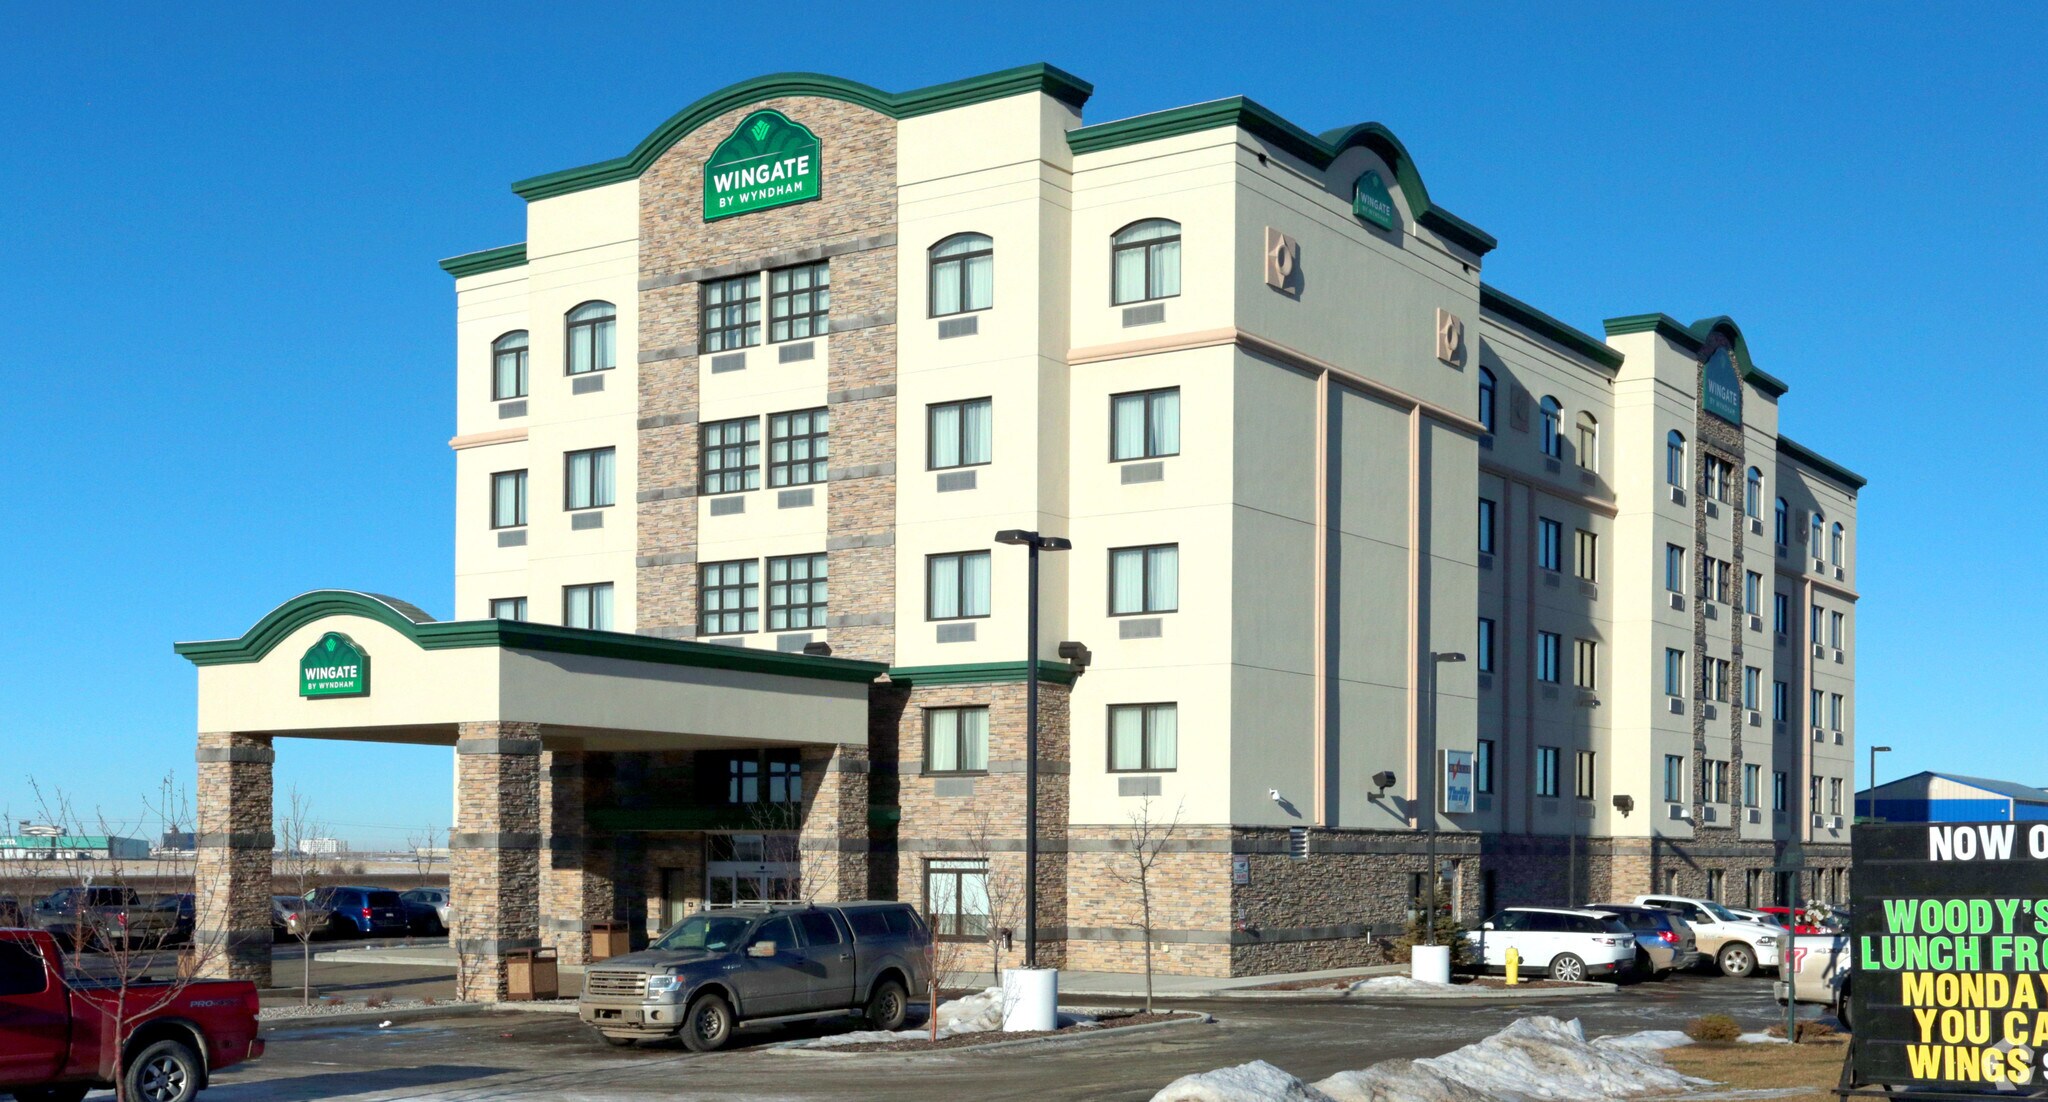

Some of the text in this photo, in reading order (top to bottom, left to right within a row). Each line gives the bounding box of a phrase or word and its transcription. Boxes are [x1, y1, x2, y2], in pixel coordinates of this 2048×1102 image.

[713, 155, 810, 193] WINGATE
[719, 181, 803, 208] BY WYNDHAM
[1360, 191, 1391, 216] WINGATE
[1708, 379, 1737, 406] WINGATE
[305, 665, 357, 680] WINGATE
[319, 681, 354, 689] WYNDHAM
[1929, 824, 2015, 861] NOW
[1883, 899, 2048, 934] WOODY'S
[1861, 935, 2048, 972] LUNCH FR
[1913, 1008, 1990, 1045] YOU
[1907, 1044, 2031, 1084] WINGS
